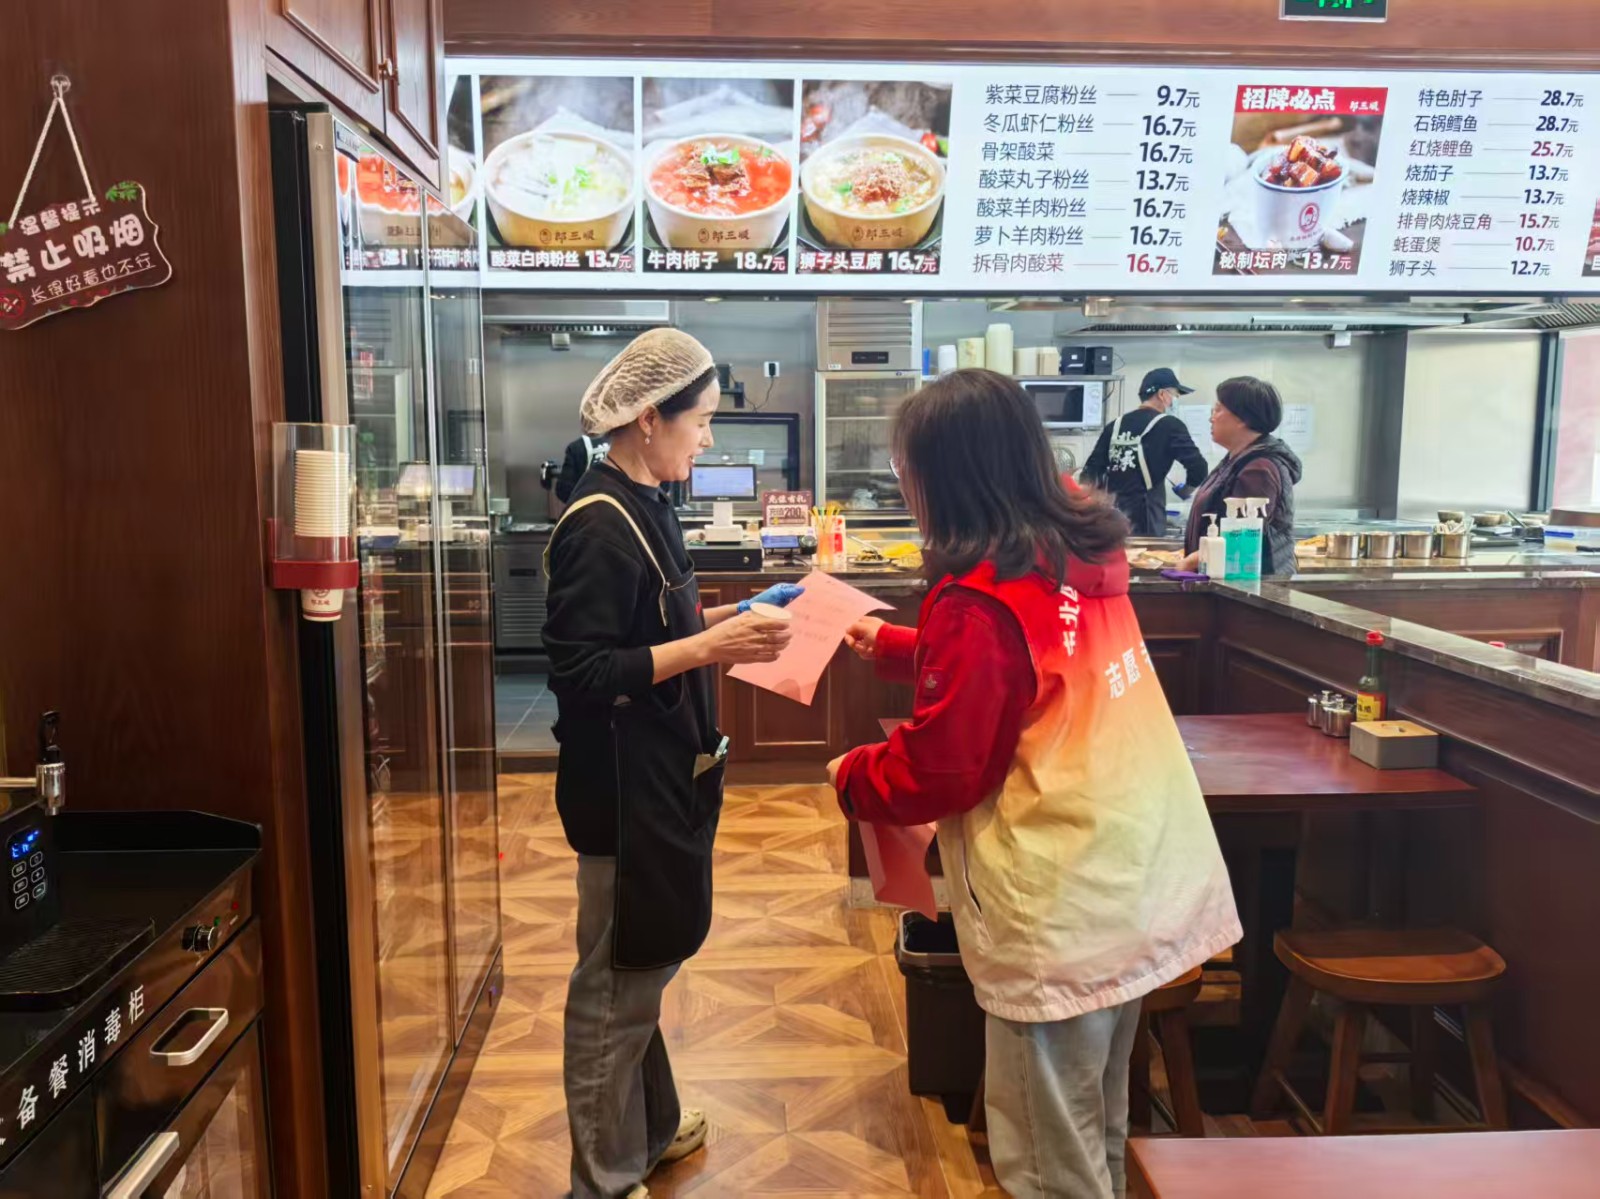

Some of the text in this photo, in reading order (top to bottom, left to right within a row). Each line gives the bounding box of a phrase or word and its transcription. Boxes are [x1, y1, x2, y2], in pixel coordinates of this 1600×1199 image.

[985, 84, 1200, 108] 紫菜豆腐粉丝 9.7元
[1242, 88, 1336, 111] 招牌必点
[1418, 89, 1584, 108] 特色肘子 28.7元
[983, 113, 1197, 137] 冬瓜虾仁粉丝 16.7元
[1413, 115, 1579, 133] 石锅鳕鱼 28.7元
[982, 142, 1193, 164] 骨架酸菜 16.7元
[1408, 140, 1574, 158] 红烧鲤鱼 25.7元
[979, 168, 1189, 191] 酸菜丸子粉丝 13.7元
[1404, 164, 1569, 182] 烧茄子 13.7元
[1400, 188, 1564, 206] 烧辣椒 13.7元
[19, 199, 102, 236] 温馨提示
[976, 197, 1186, 219] 酸菜羊肉粉丝 16.7元
[1396, 213, 1560, 231] 排骨肉烧豆角 15.7元
[973, 225, 1182, 247] 萝卜羊肉粉丝 16.7元
[1515, 236, 1555, 251] 10.7元
[0, 213, 145, 284] 禁止吸烟
[490, 250, 580, 268] 酸菜白肉粉丝
[584, 250, 632, 269] 13.7元
[647, 250, 786, 271] 牛肉柿子 18.7元
[799, 251, 937, 272] 狮子头豆腐 16.7元
[972, 253, 1178, 274] 拆骨肉酸菜 16.7元
[1219, 251, 1352, 270] 秘制坛肉 13.7元
[1388, 259, 1551, 277] 狮子头 12.7元
[30, 253, 152, 300] 长得好看也不行
[0, 985, 145, 1147] 备餐消毒柜
